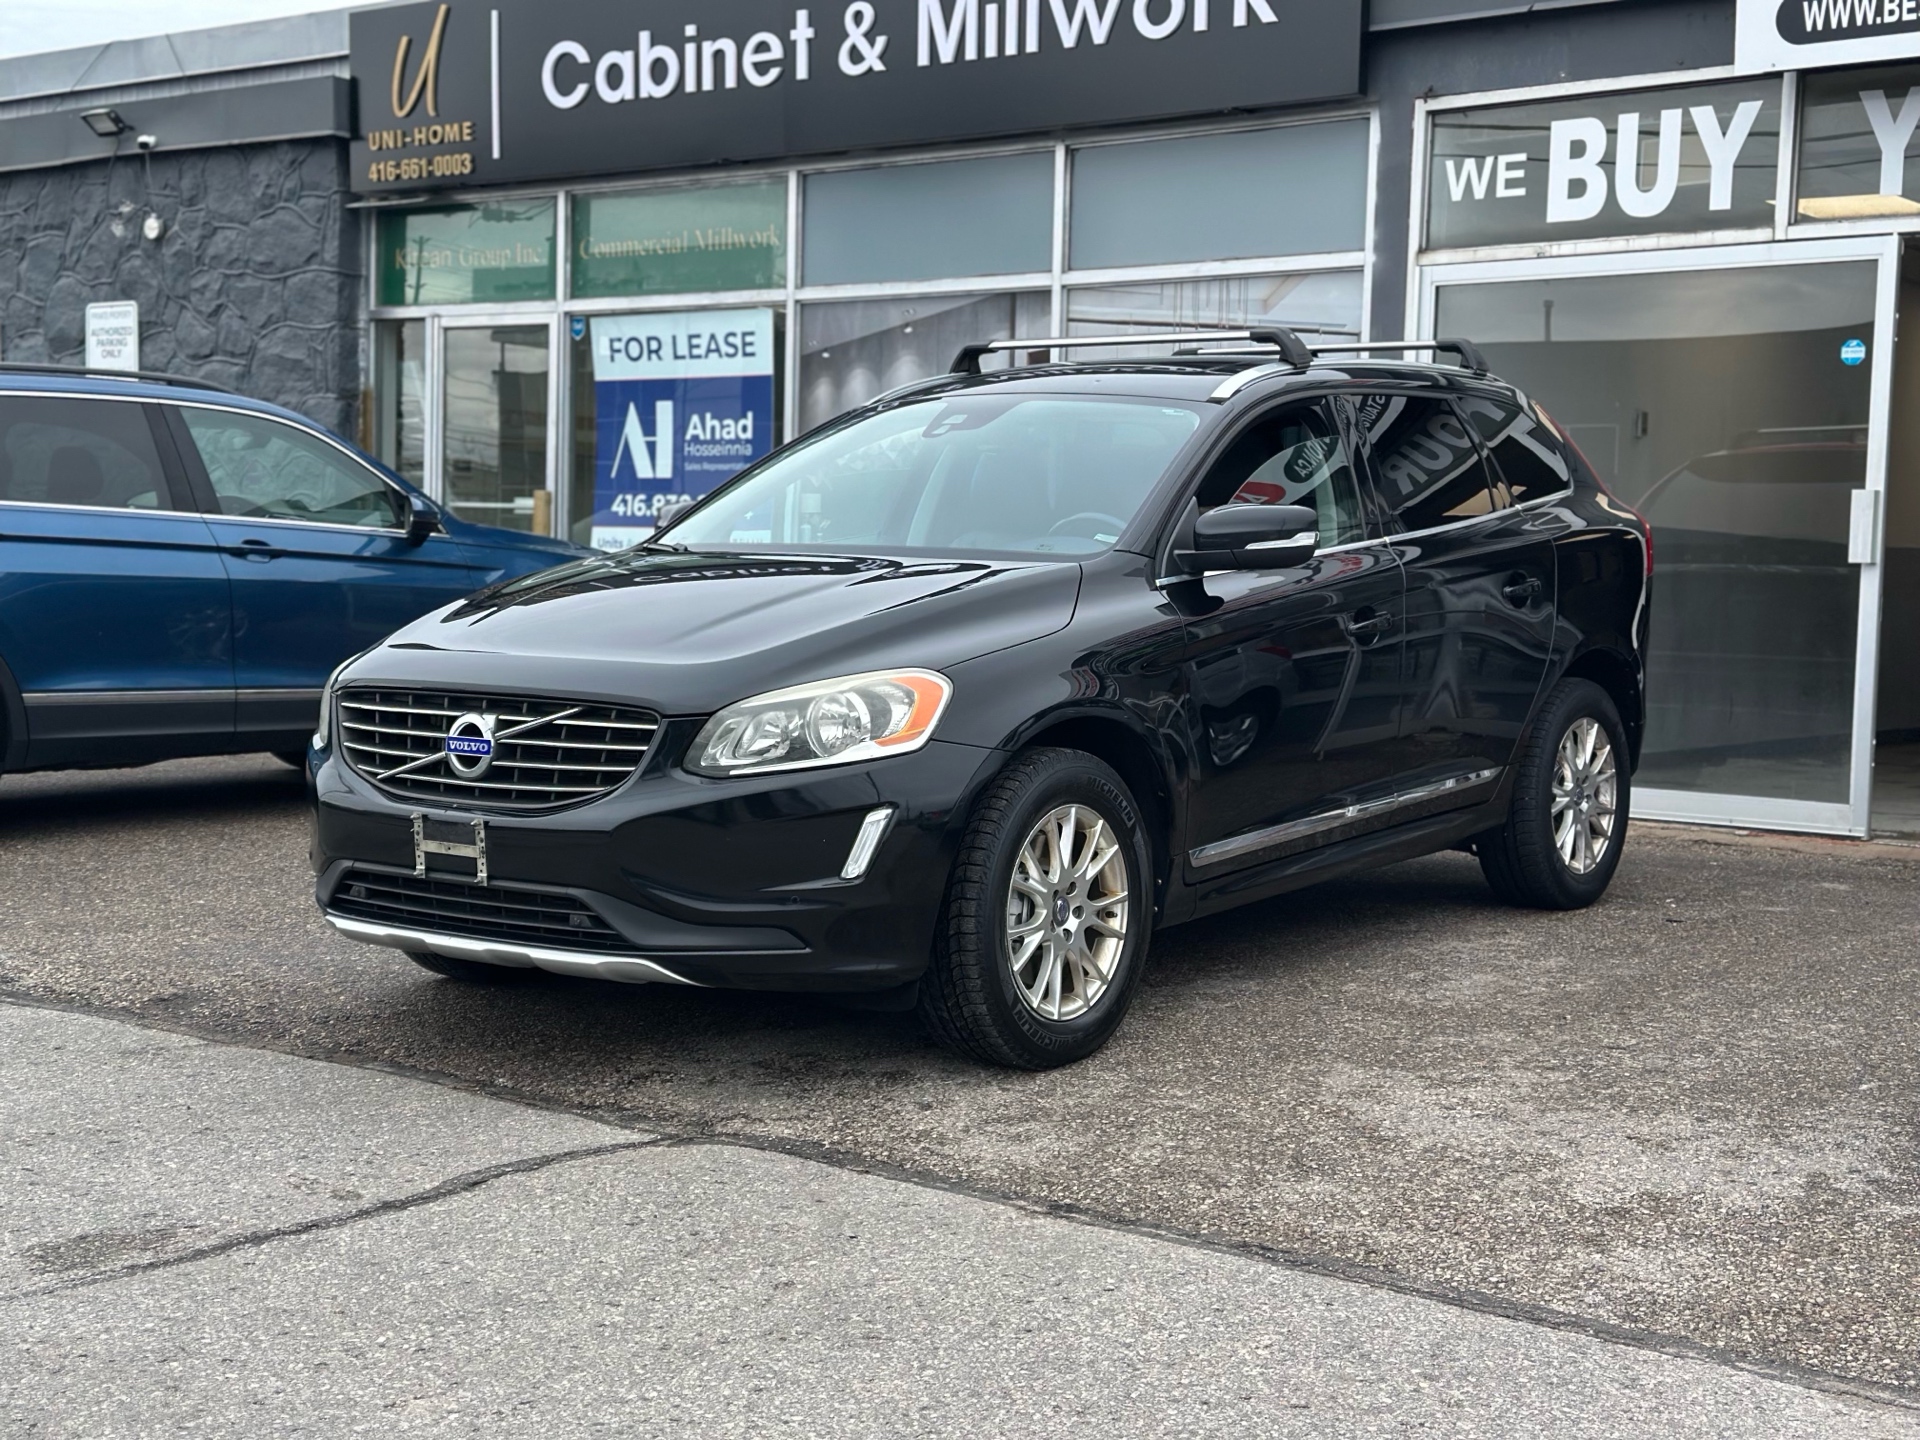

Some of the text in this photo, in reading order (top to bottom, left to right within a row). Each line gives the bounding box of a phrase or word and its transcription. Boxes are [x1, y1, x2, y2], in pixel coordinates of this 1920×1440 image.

[1803, 0, 1920, 32] WWW.BE
[541, 9, 815, 109] Cabinet
[838, 0, 888, 76] &
[368, 121, 473, 151] UNI-HOME
[368, 153, 473, 182] 416-661-0003
[1445, 152, 1528, 202] WE
[1546, 100, 1764, 224] BUY
[579, 223, 781, 260] Commercial Millwork
[458, 246, 511, 271] Group
[96, 337, 128, 347] PARKING
[101, 349, 122, 359] ONLY
[609, 331, 756, 363] FOR LEASE
[684, 411, 753, 440] Ahad
[683, 441, 753, 457] Hosseinnia
[597, 536, 624, 549] Units
[448, 740, 489, 752] VOLVO
[1086, 775, 1135, 825] MICHELIN
